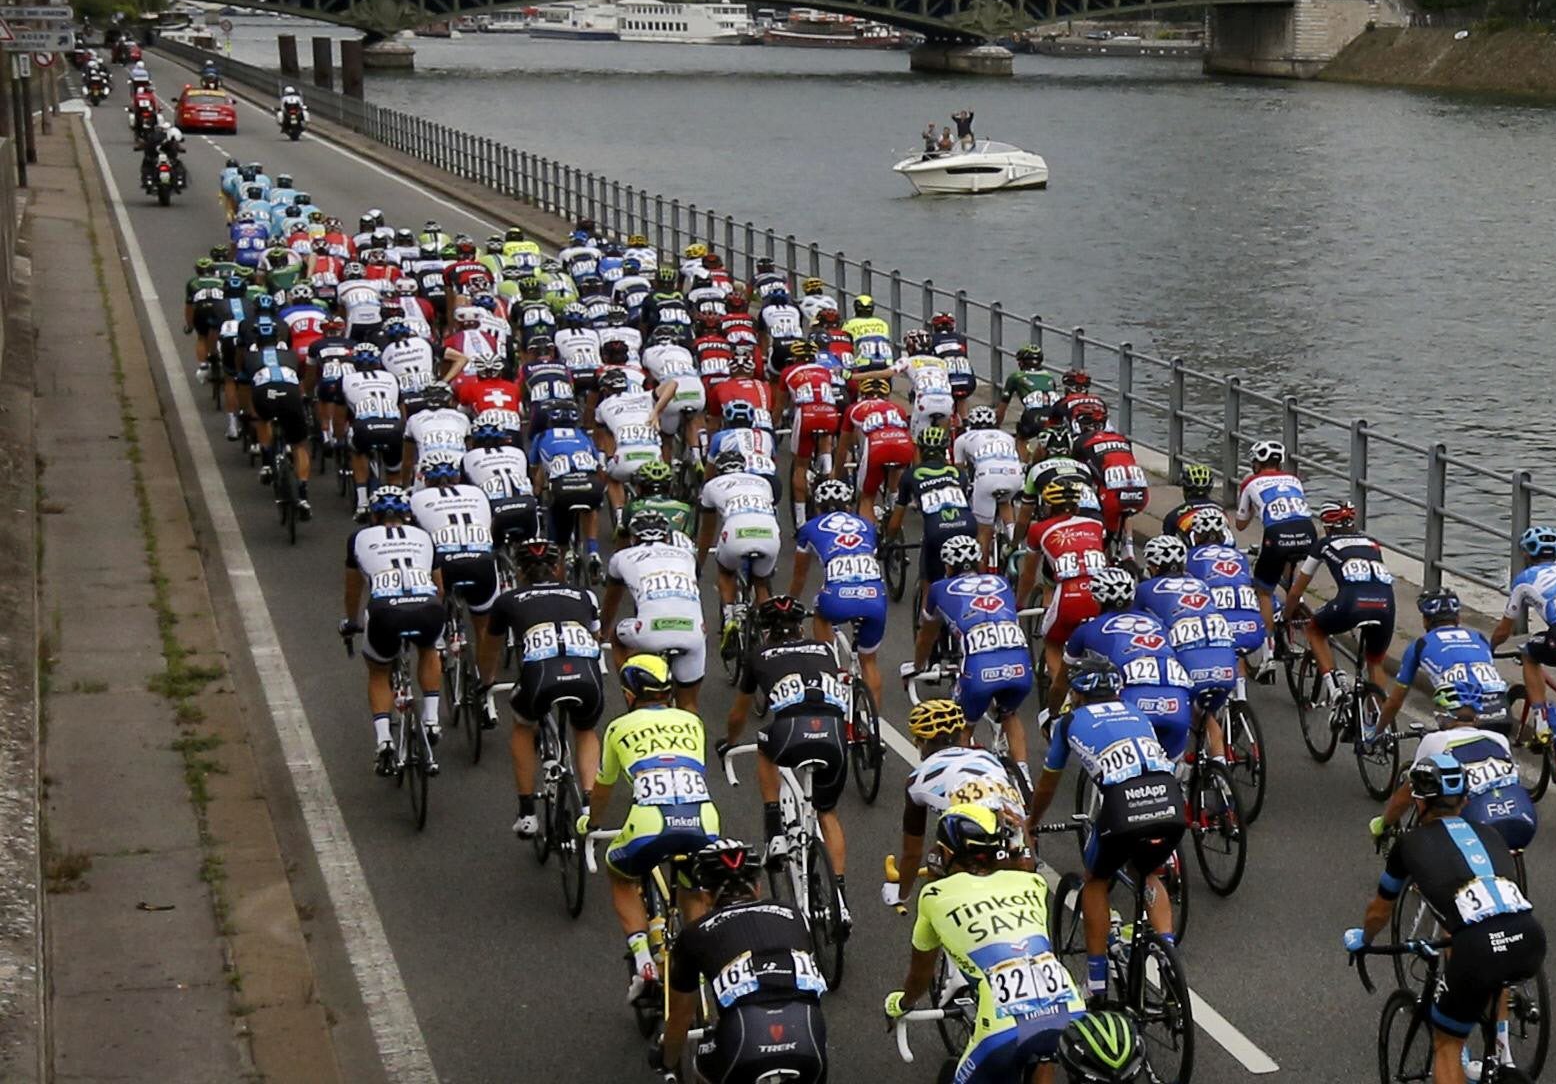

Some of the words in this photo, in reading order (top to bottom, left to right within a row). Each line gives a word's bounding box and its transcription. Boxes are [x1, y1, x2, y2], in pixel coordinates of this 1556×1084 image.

[1271, 501, 1287, 516] 96
[829, 557, 853, 577] 124
[375, 571, 401, 589] 109
[525, 629, 554, 653] 165
[970, 627, 998, 651] 125
[1173, 626, 1201, 645] 128
[1127, 661, 1159, 682] 122
[618, 722, 700, 750] Tinkoff
[634, 736, 698, 759] SAXO
[1101, 745, 1136, 773] 208
[1468, 761, 1491, 786] 87
[640, 773, 667, 799] 35
[955, 781, 984, 805] 83
[1124, 784, 1168, 801] NetApp
[1487, 799, 1516, 818] F&F
[665, 816, 701, 827] Tinkoff
[946, 889, 1043, 928] Tinkoff
[1465, 888, 1482, 911] 3
[967, 908, 1045, 944] SAXO
[1490, 933, 1524, 947] CENTURY
[1492, 944, 1508, 953] FOX
[719, 957, 758, 995] 164
[995, 967, 1029, 1004] 32
[758, 1041, 799, 1053] TREK
